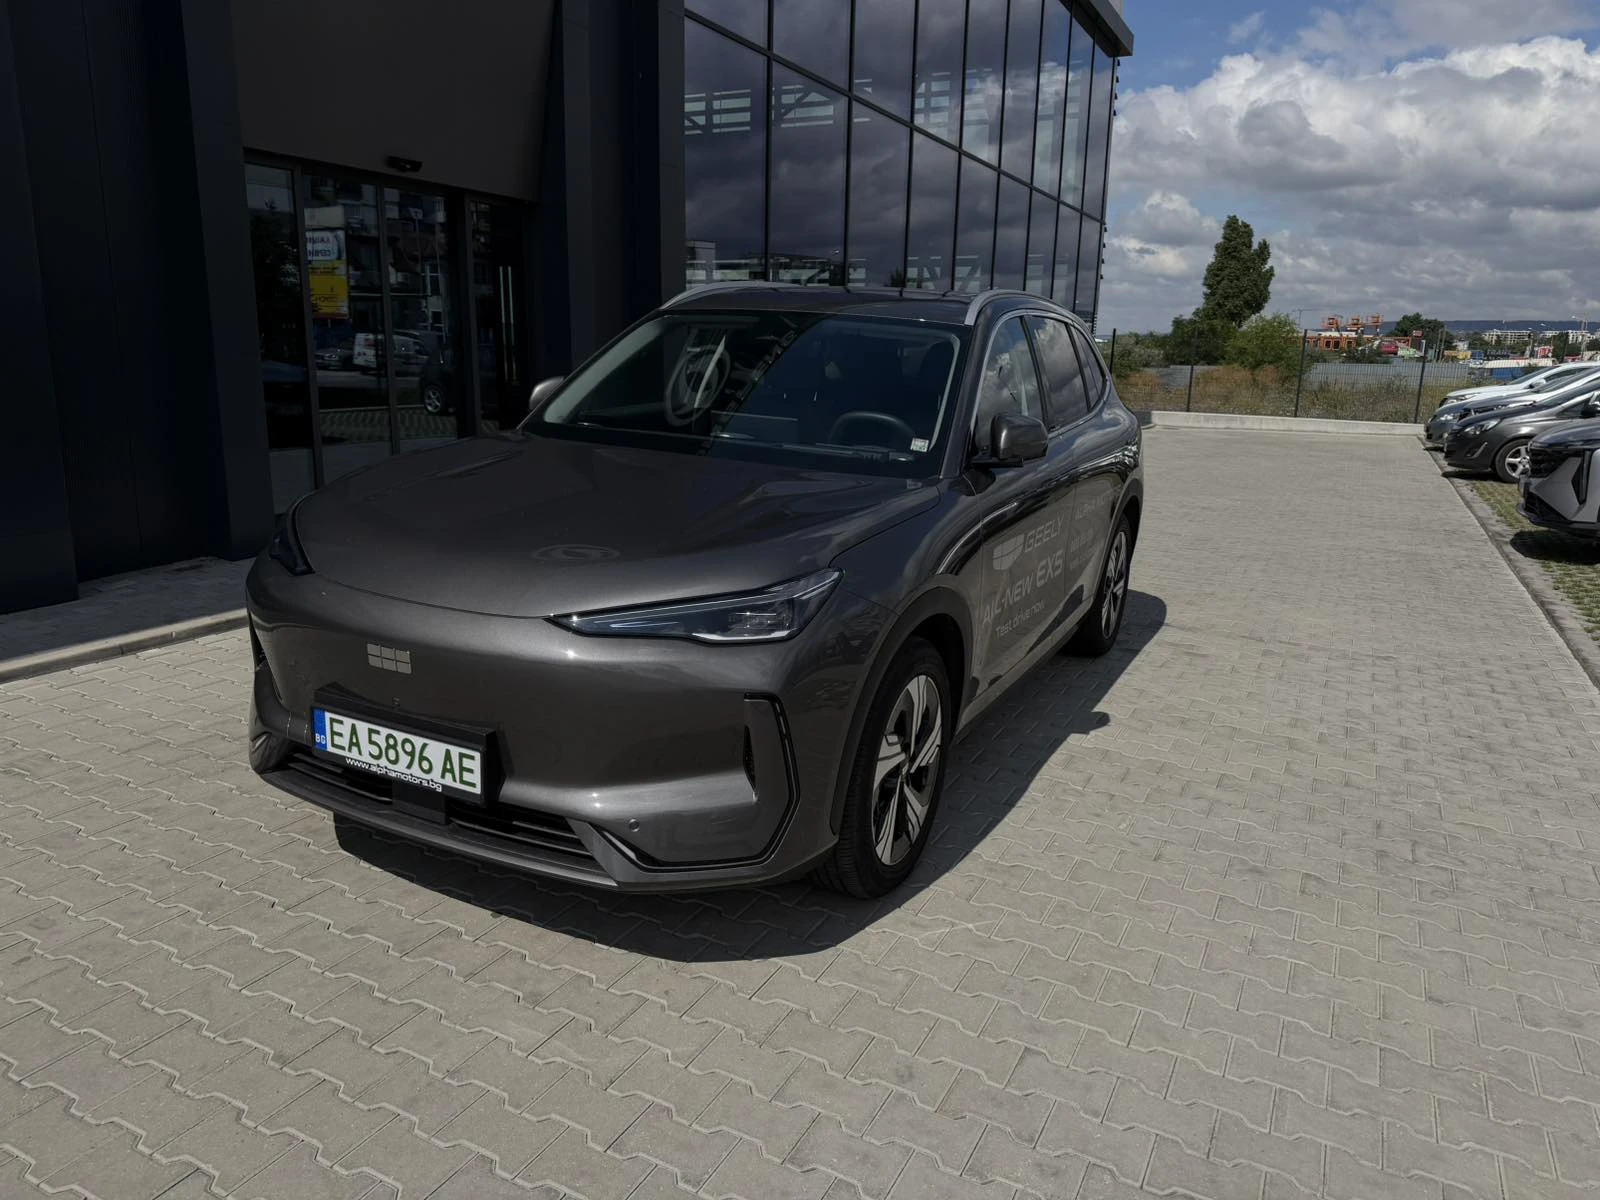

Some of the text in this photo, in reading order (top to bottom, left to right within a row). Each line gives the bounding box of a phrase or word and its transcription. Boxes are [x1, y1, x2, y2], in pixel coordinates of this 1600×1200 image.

[1024, 514, 1065, 552] GEELY
[315, 734, 326, 745] BG
[329, 717, 477, 788] EA 5896 AE
[346, 757, 443, 792] www.alphamotors.bg
